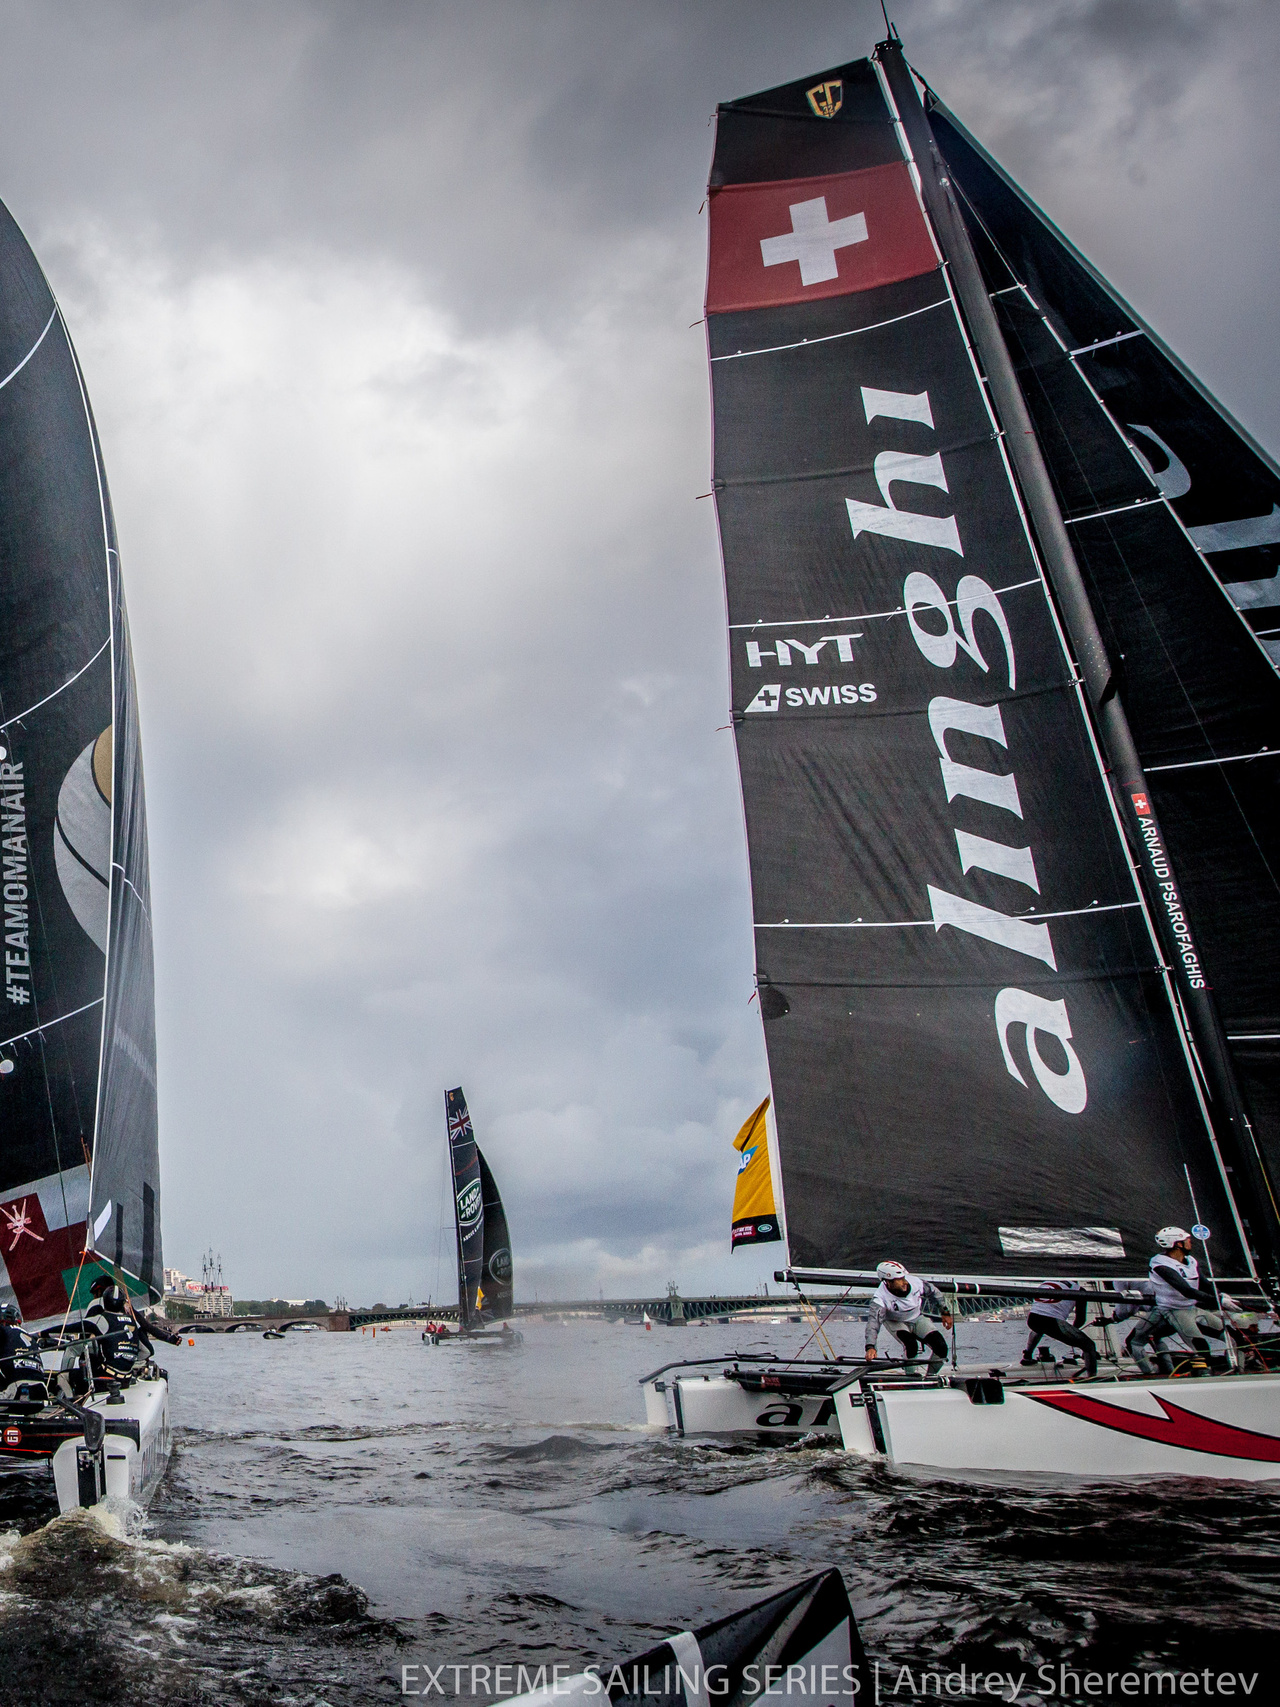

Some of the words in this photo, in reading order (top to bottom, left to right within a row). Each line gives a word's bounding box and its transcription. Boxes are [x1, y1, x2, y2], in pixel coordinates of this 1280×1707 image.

[745, 633, 864, 667] HYT
[785, 683, 877, 707] SWISS
[845, 386, 1088, 1114] alinghi
[0, 761, 30, 1005] #TEAMOMANAIR
[1138, 817, 1170, 879] ARNAUD
[1158, 873, 1205, 990] PSAROFAGHIS
[740, 1153, 751, 1171] AP
